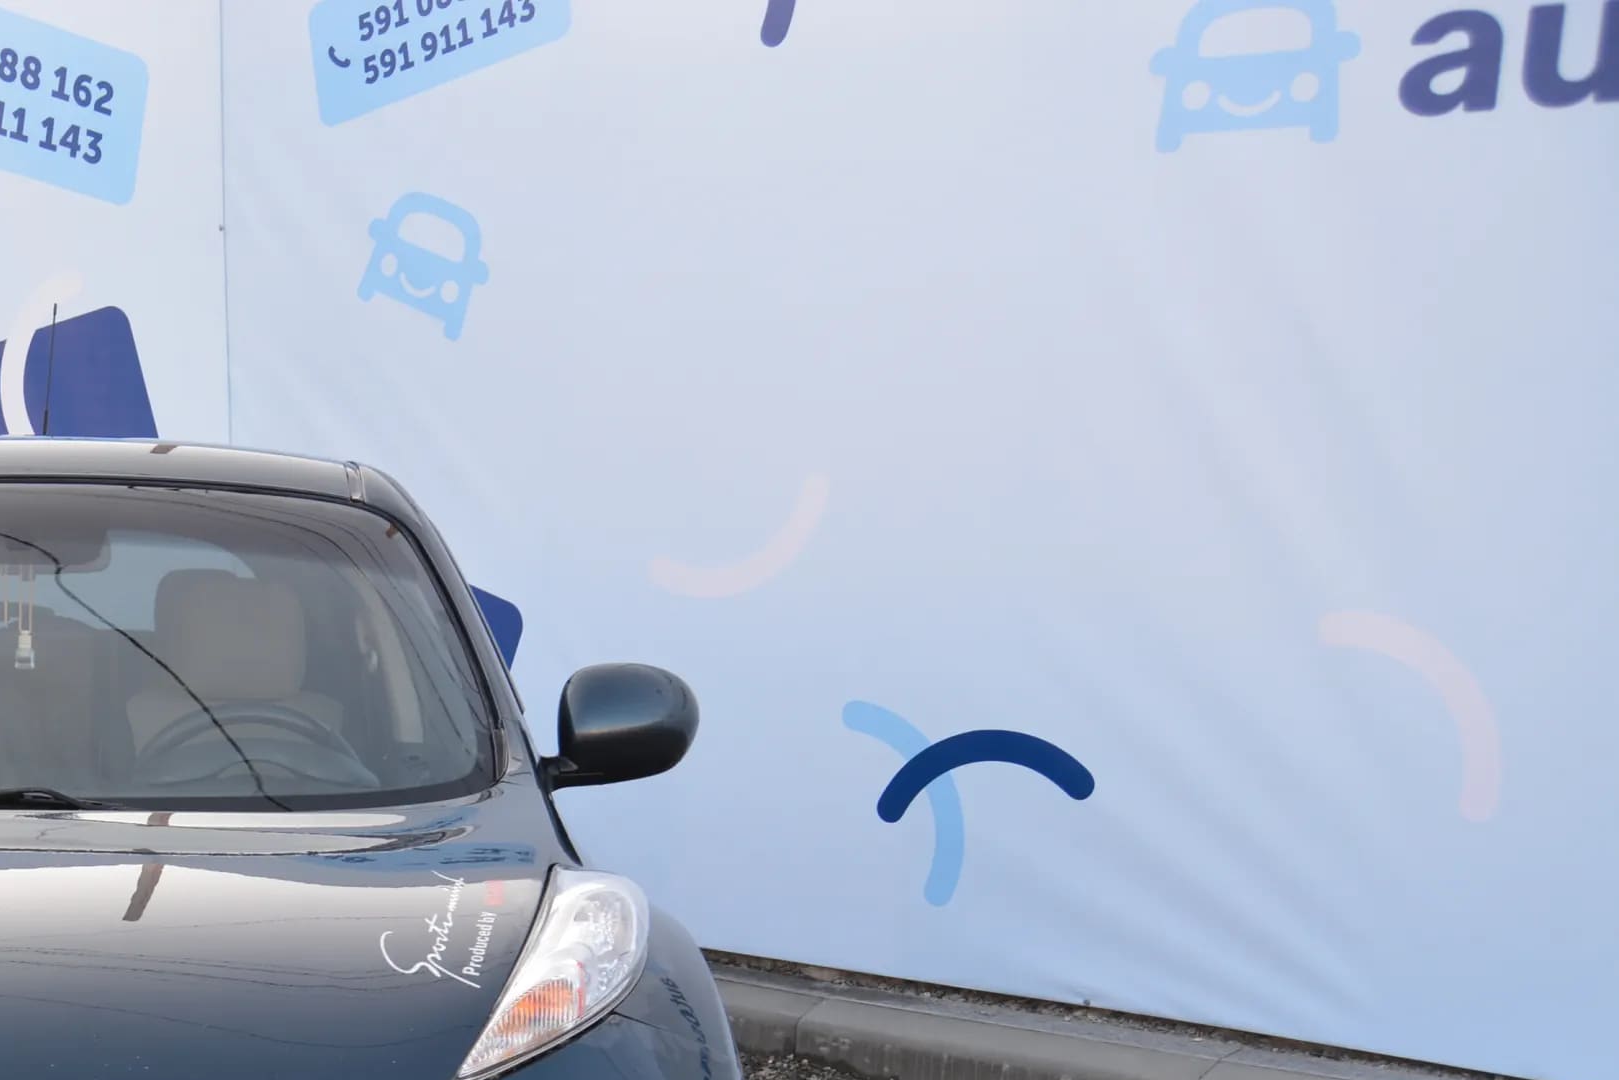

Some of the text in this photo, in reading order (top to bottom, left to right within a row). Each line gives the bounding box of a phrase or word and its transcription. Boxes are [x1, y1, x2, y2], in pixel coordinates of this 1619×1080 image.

[357, 0, 410, 42] 591
[362, 41, 415, 85] 591
[420, 17, 474, 63] 911
[480, 0, 536, 39] 143
[51, 66, 114, 117] 162
[38, 116, 104, 165] 143
[462, 923, 495, 976] Produced
